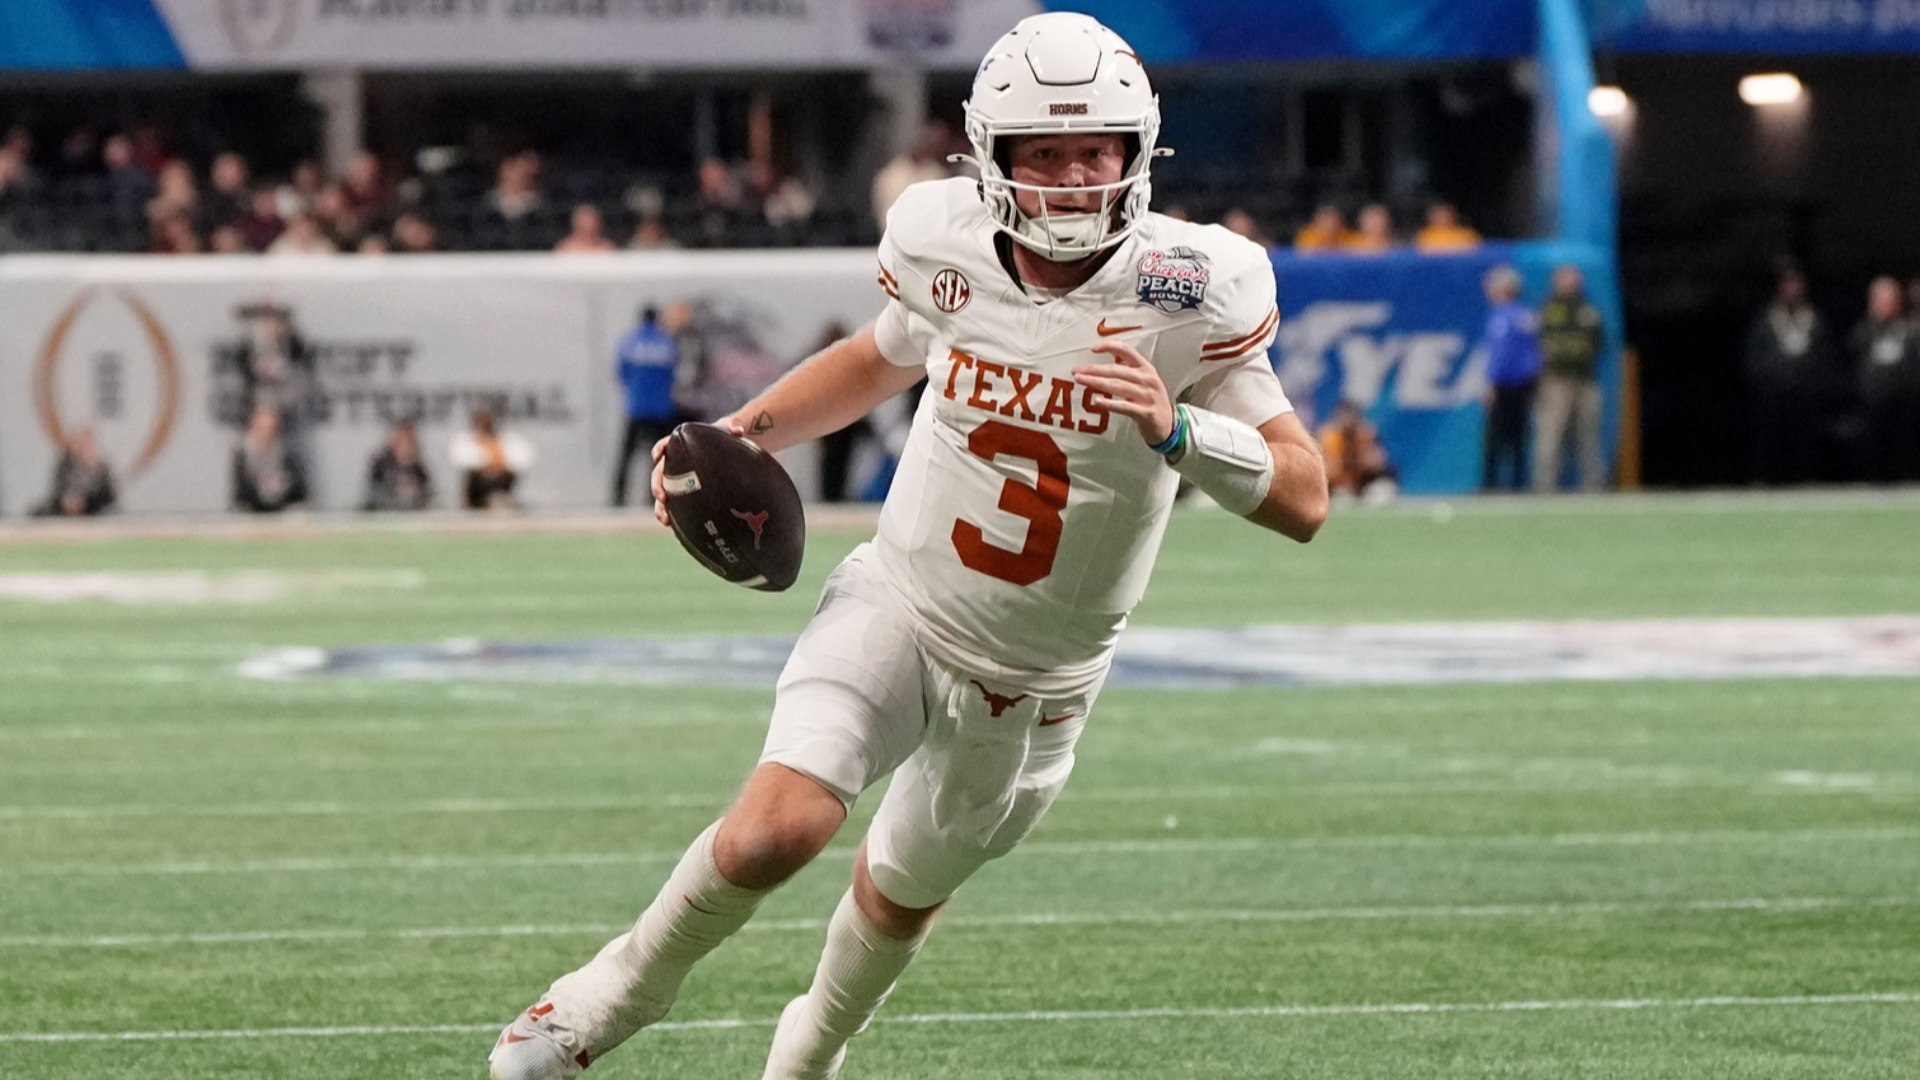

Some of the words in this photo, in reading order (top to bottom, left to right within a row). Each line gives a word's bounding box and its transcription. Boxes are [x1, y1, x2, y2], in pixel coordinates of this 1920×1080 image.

[1049, 103, 1088, 116] HORNS
[934, 271, 968, 310] SEC
[1138, 276, 1204, 300] PEACH
[1149, 293, 1189, 304] BOWL
[943, 349, 1112, 435] TEXAS
[951, 419, 1070, 587] 3
